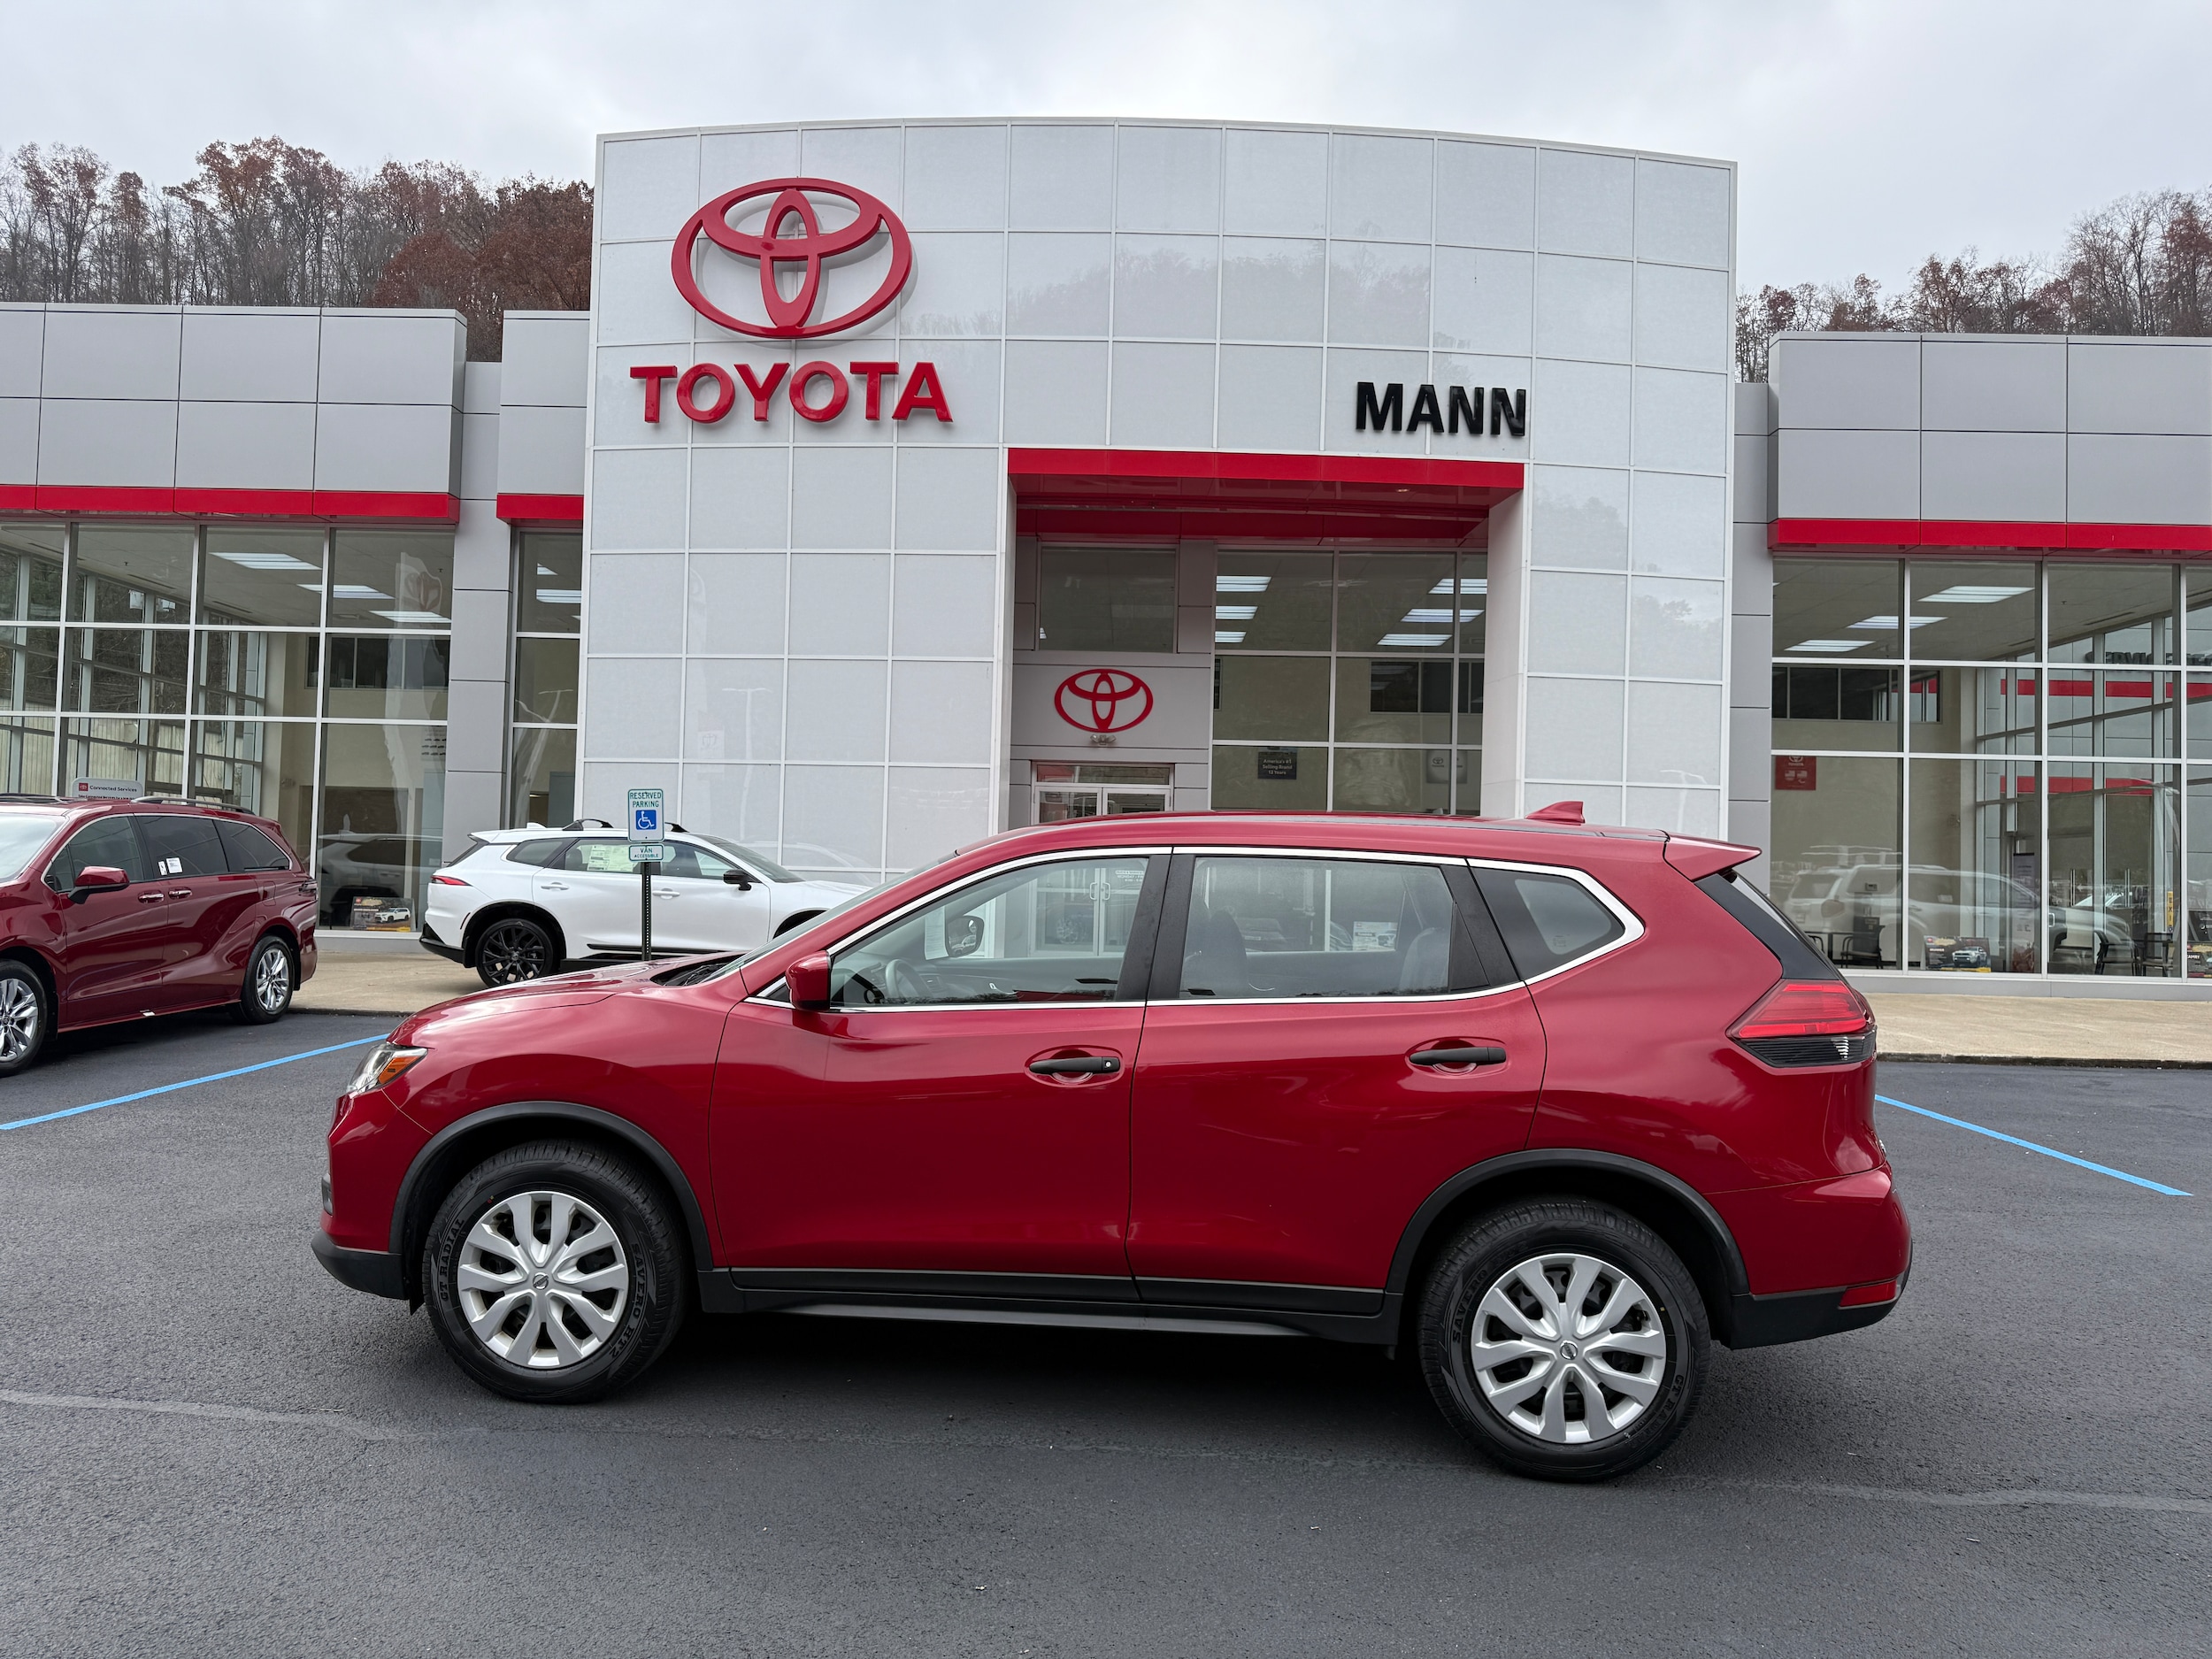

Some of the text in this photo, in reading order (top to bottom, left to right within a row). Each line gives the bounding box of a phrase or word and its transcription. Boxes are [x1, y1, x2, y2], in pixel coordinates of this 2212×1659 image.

[630, 360, 954, 424] TOYOTA
[1356, 381, 1526, 436] MANN
[440, 1218, 465, 1300] GT RADIAL
[610, 1242, 646, 1358] SAVERO HT2
[1452, 1269, 1488, 1344] SAVERO
[1671, 1374, 1685, 1396] GT
